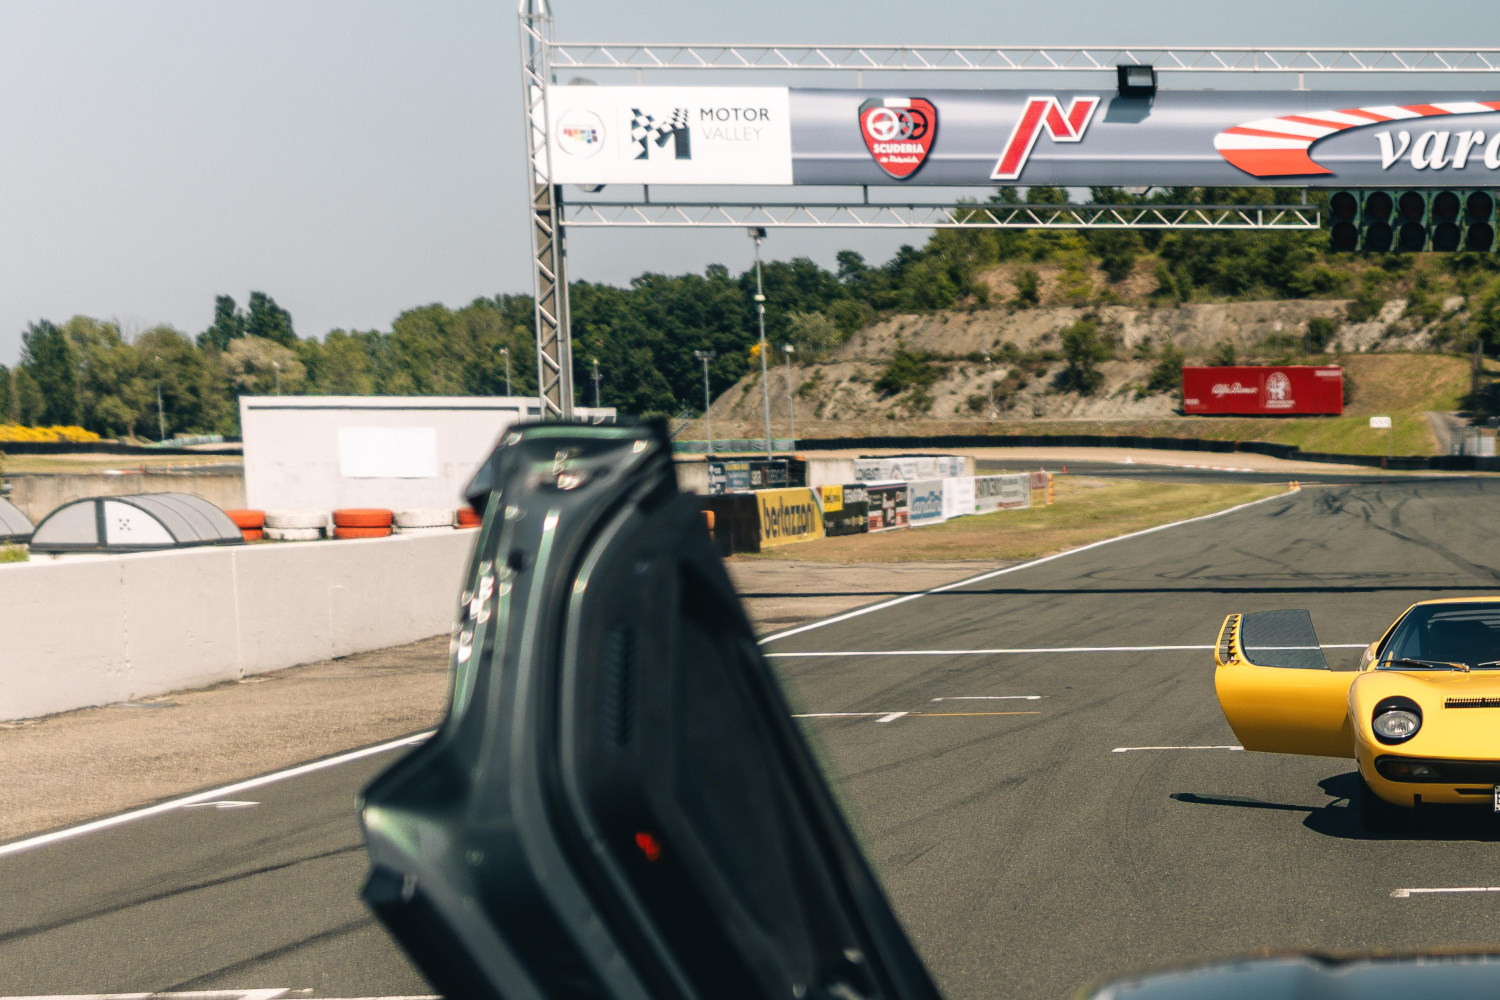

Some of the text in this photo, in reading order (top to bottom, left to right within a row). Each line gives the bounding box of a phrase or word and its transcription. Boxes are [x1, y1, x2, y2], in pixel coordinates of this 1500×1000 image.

[700, 108, 770, 122] MOTOR
[702, 127, 763, 141] VALLEY
[873, 143, 925, 154] SCUDERIA
